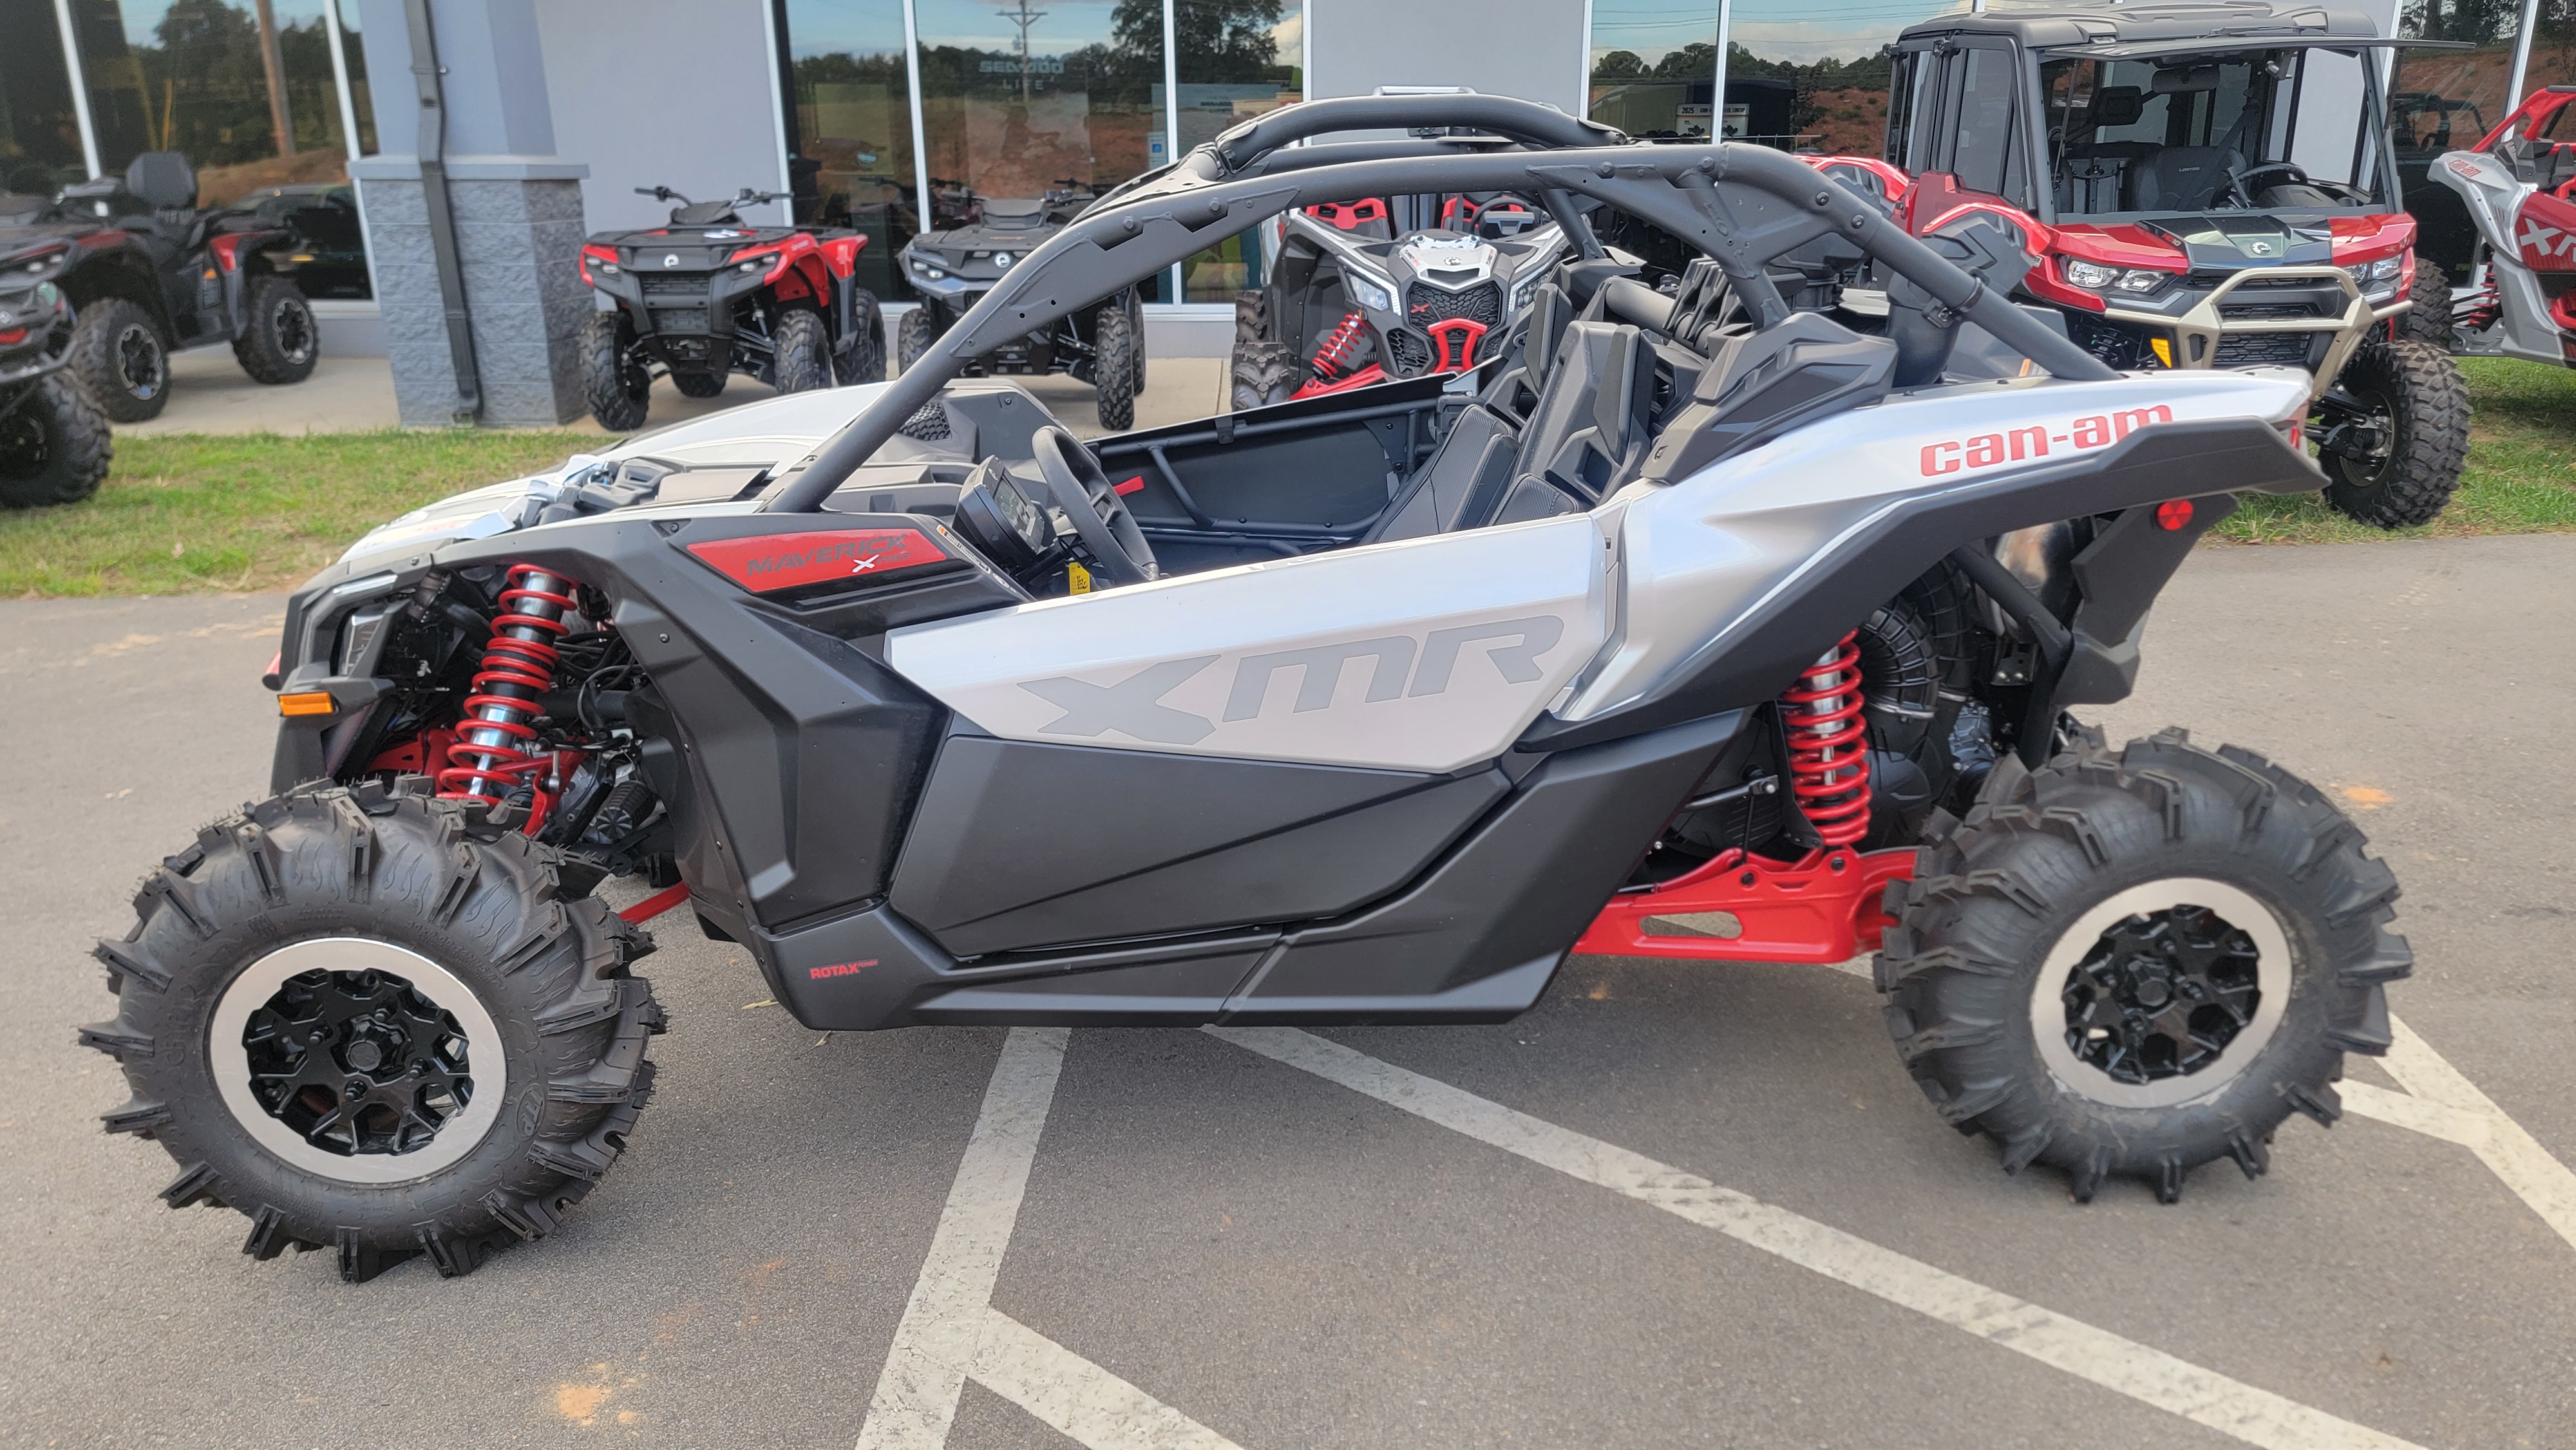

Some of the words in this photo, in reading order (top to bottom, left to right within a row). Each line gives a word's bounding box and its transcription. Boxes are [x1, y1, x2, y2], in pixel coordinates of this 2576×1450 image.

[2448, 160, 2482, 178] can-am
[1920, 404, 2172, 476] can-am
[747, 533, 909, 576] MAVERICK
[810, 963, 859, 979] ROTAX
